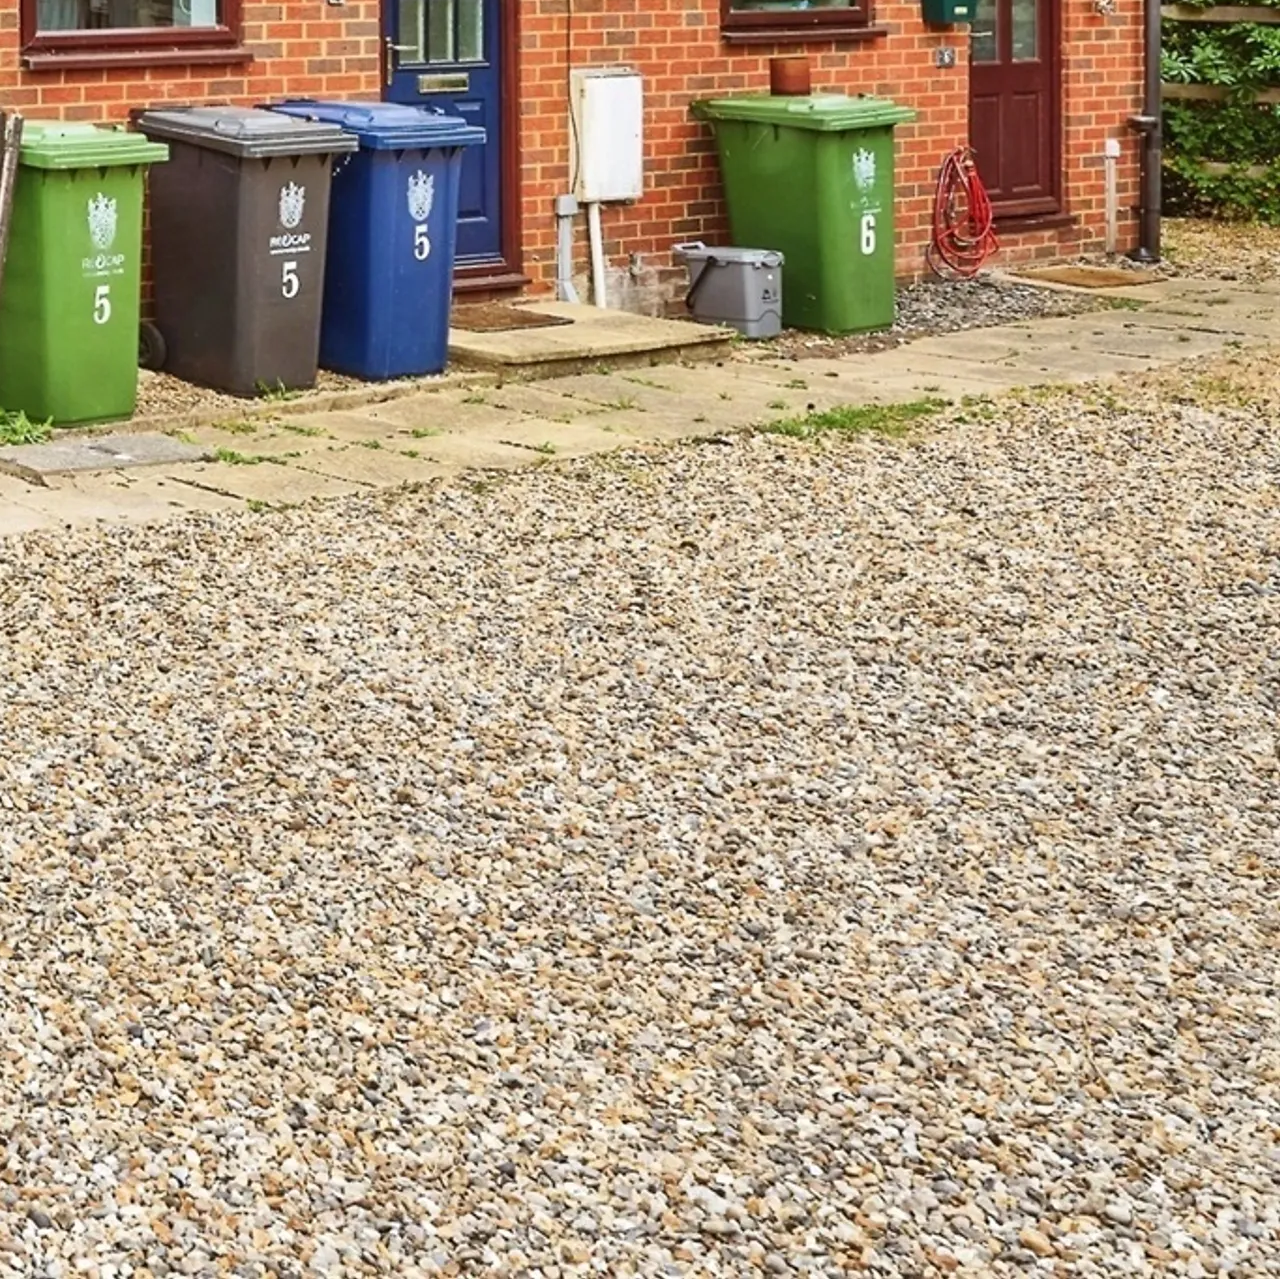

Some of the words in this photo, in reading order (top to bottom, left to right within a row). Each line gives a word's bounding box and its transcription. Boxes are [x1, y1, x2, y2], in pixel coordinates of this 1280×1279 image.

[414, 223, 430, 261] 5
[861, 214, 876, 255] 6
[282, 261, 299, 298] 5
[93, 285, 111, 325] 5
